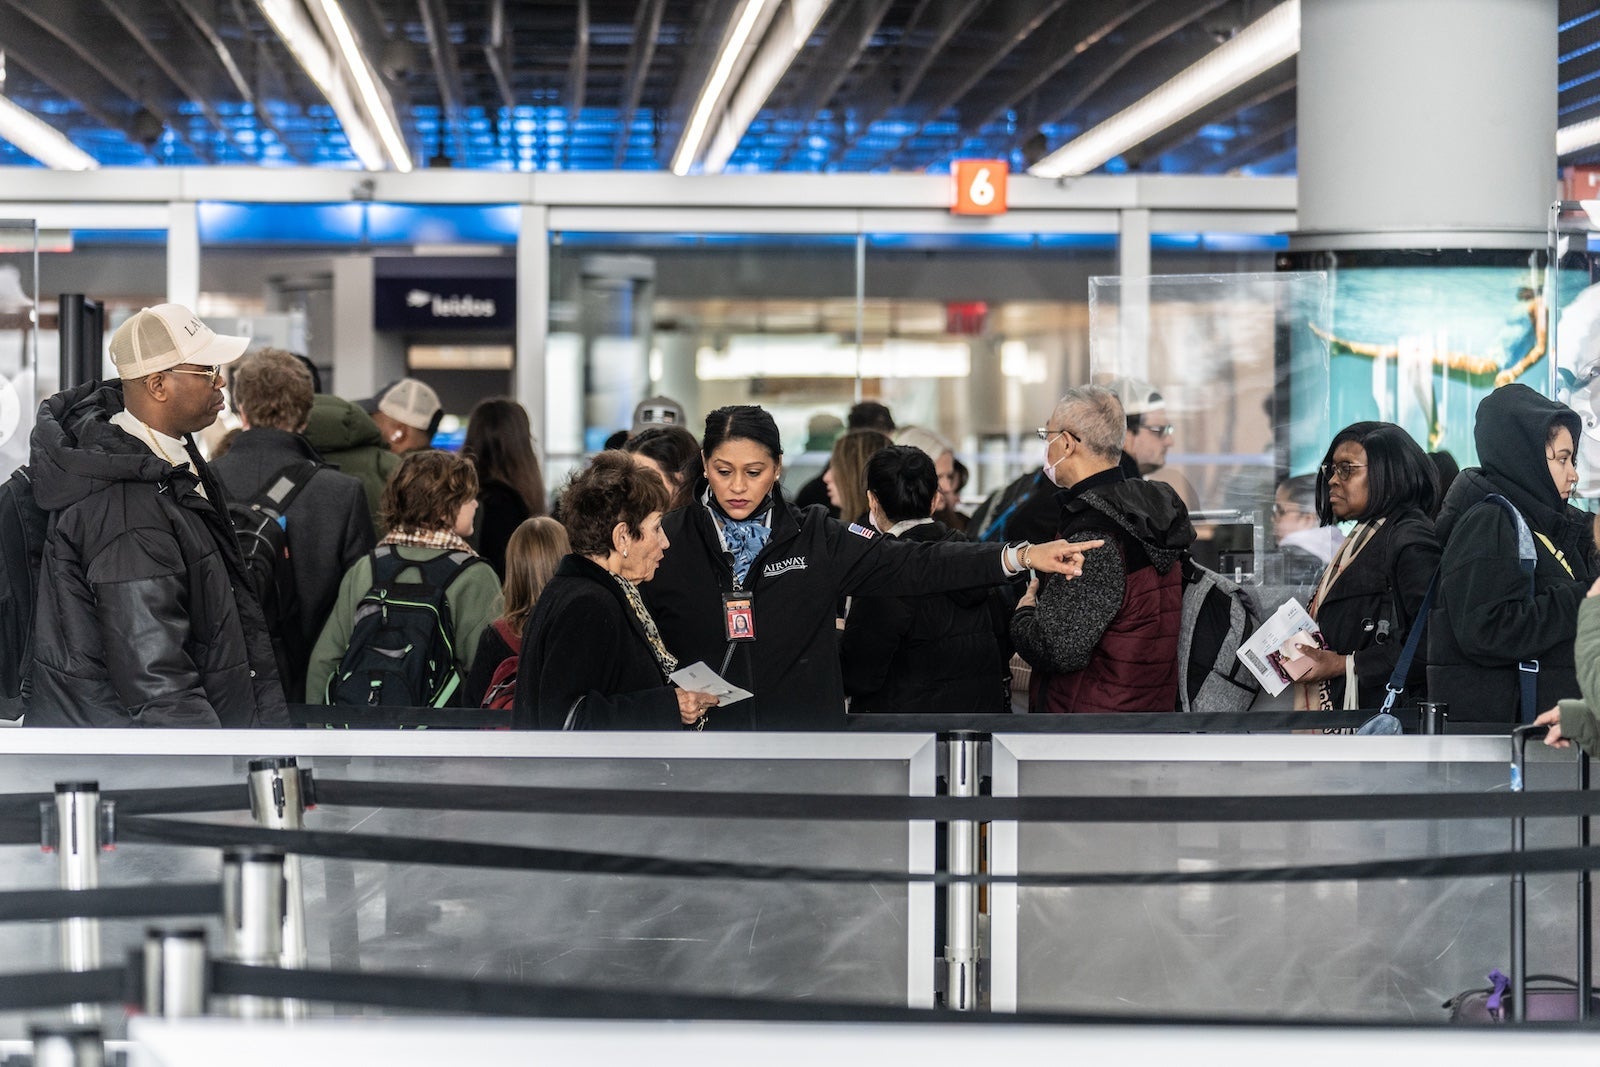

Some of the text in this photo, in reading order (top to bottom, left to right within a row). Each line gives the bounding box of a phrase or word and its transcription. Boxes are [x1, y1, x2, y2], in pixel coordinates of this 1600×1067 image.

[969, 167, 995, 206] 6
[431, 294, 496, 317] leidos
[763, 556, 806, 573] AIRWAY
